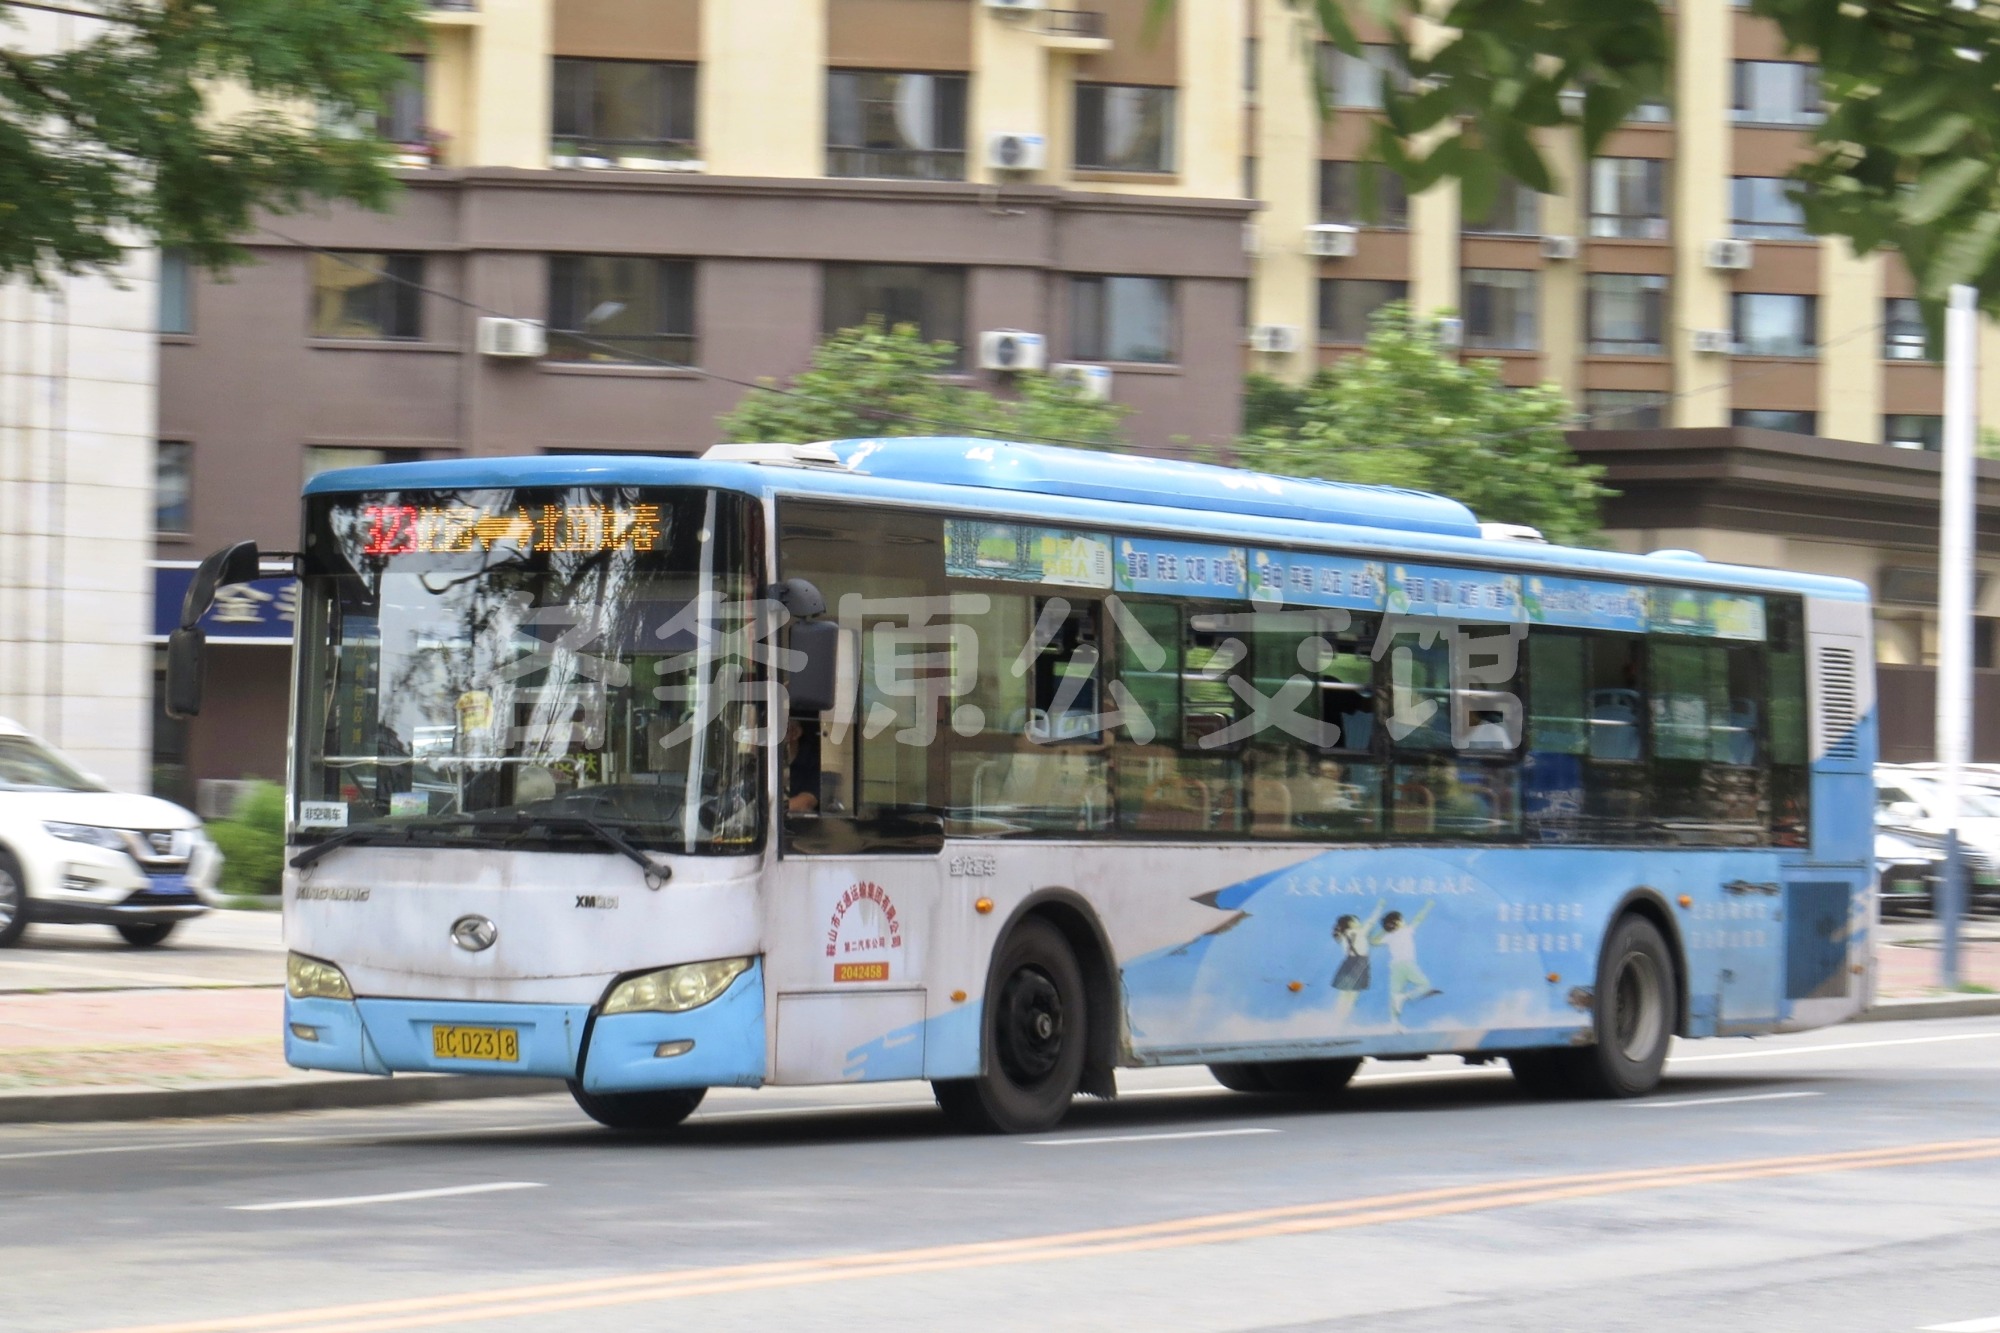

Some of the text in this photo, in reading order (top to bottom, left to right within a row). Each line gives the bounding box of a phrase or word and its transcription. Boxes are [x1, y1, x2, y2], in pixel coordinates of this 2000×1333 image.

[364, 505, 417, 554] 323
[844, 936, 886, 954] 第二汽车公司
[841, 964, 883, 980] 2042458
